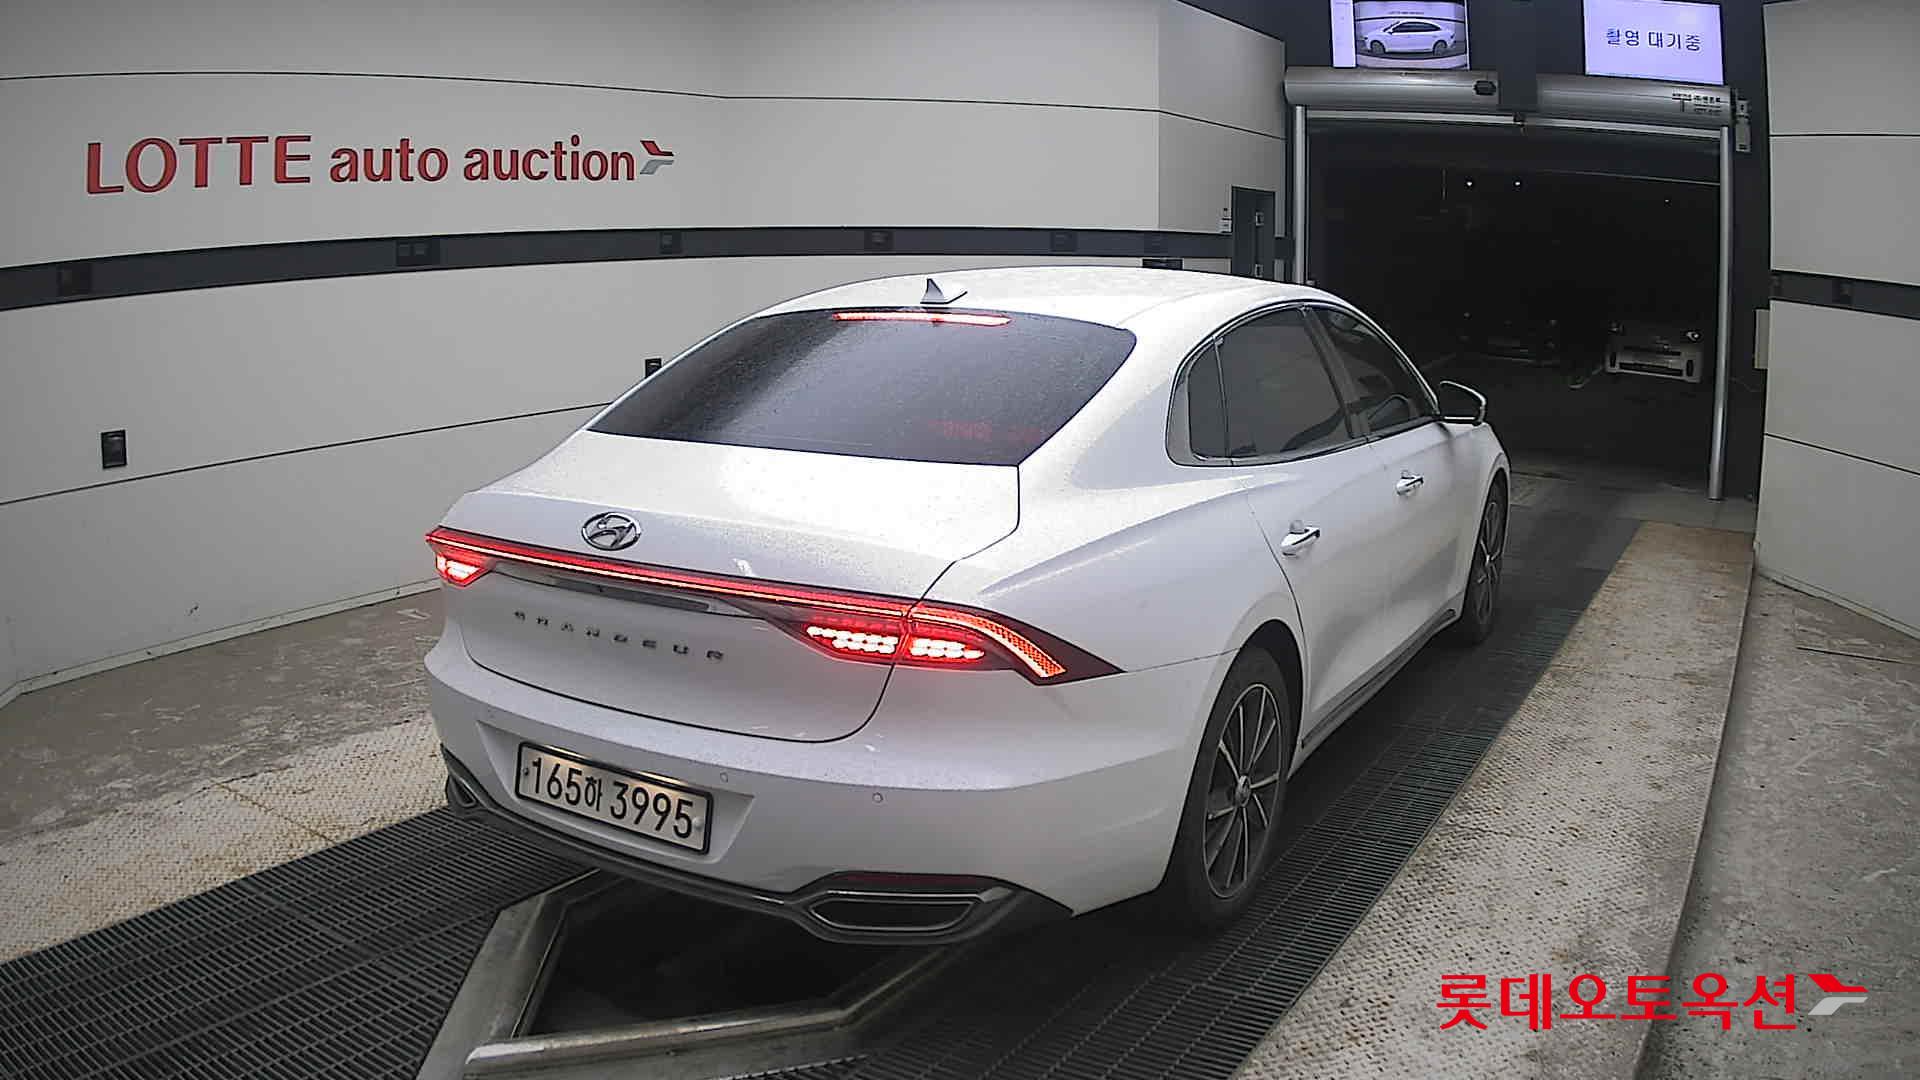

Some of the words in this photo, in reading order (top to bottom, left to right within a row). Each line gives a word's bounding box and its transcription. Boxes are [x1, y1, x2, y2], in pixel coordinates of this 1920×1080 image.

[1648, 31, 1701, 52] 대기중
[87, 135, 312, 194] LOTTE
[329, 138, 449, 183] auto
[463, 134, 635, 182] auction
[532, 757, 603, 812] 165하
[610, 781, 694, 839] 3995
